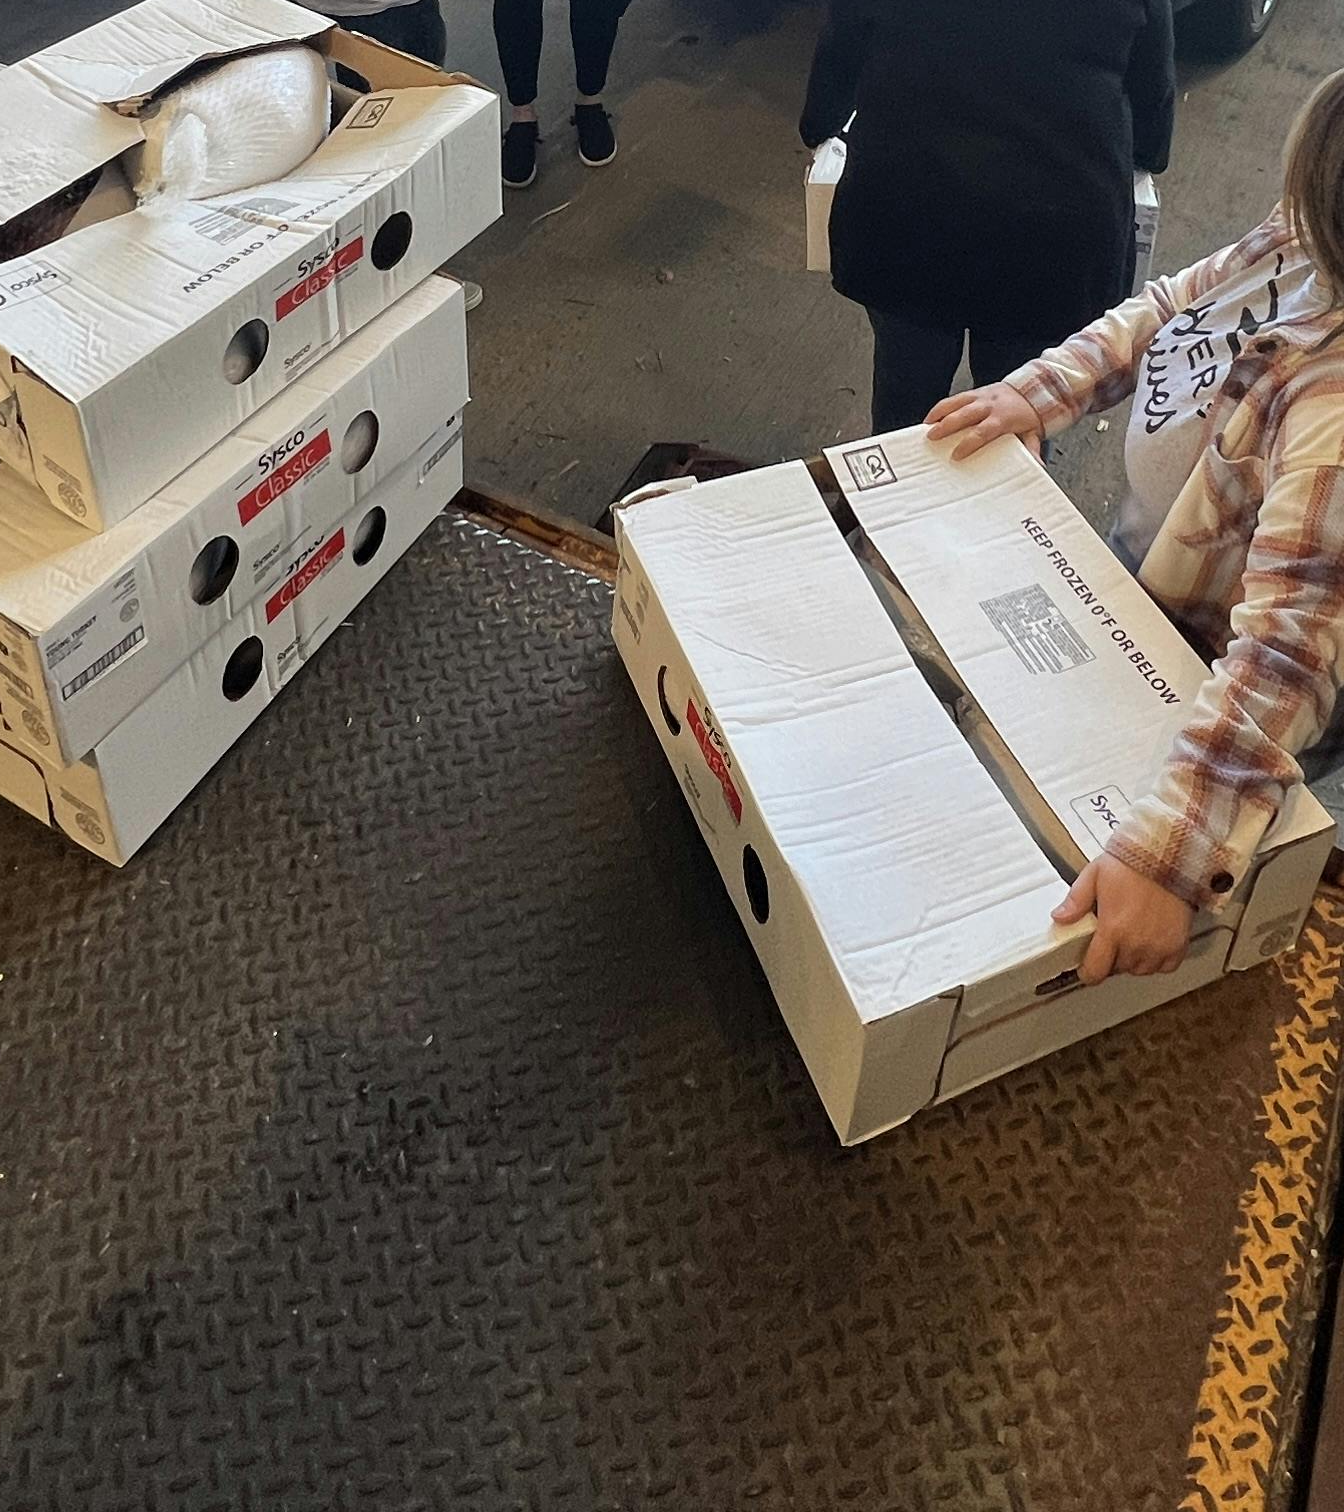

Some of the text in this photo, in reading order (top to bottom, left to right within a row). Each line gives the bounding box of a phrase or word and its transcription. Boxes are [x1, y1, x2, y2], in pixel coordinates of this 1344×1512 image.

[238, 240, 265, 258] OR
[9, 269, 59, 293] Sysco
[182, 255, 241, 294] BELOW
[258, 430, 305, 475] Sysco
[255, 449, 318, 508] Classic
[280, 545, 332, 606] Classic
[1020, 516, 1182, 706] KEEP FROZEN 0°F OR BELOW
[1089, 794, 1121, 830] Sysc
